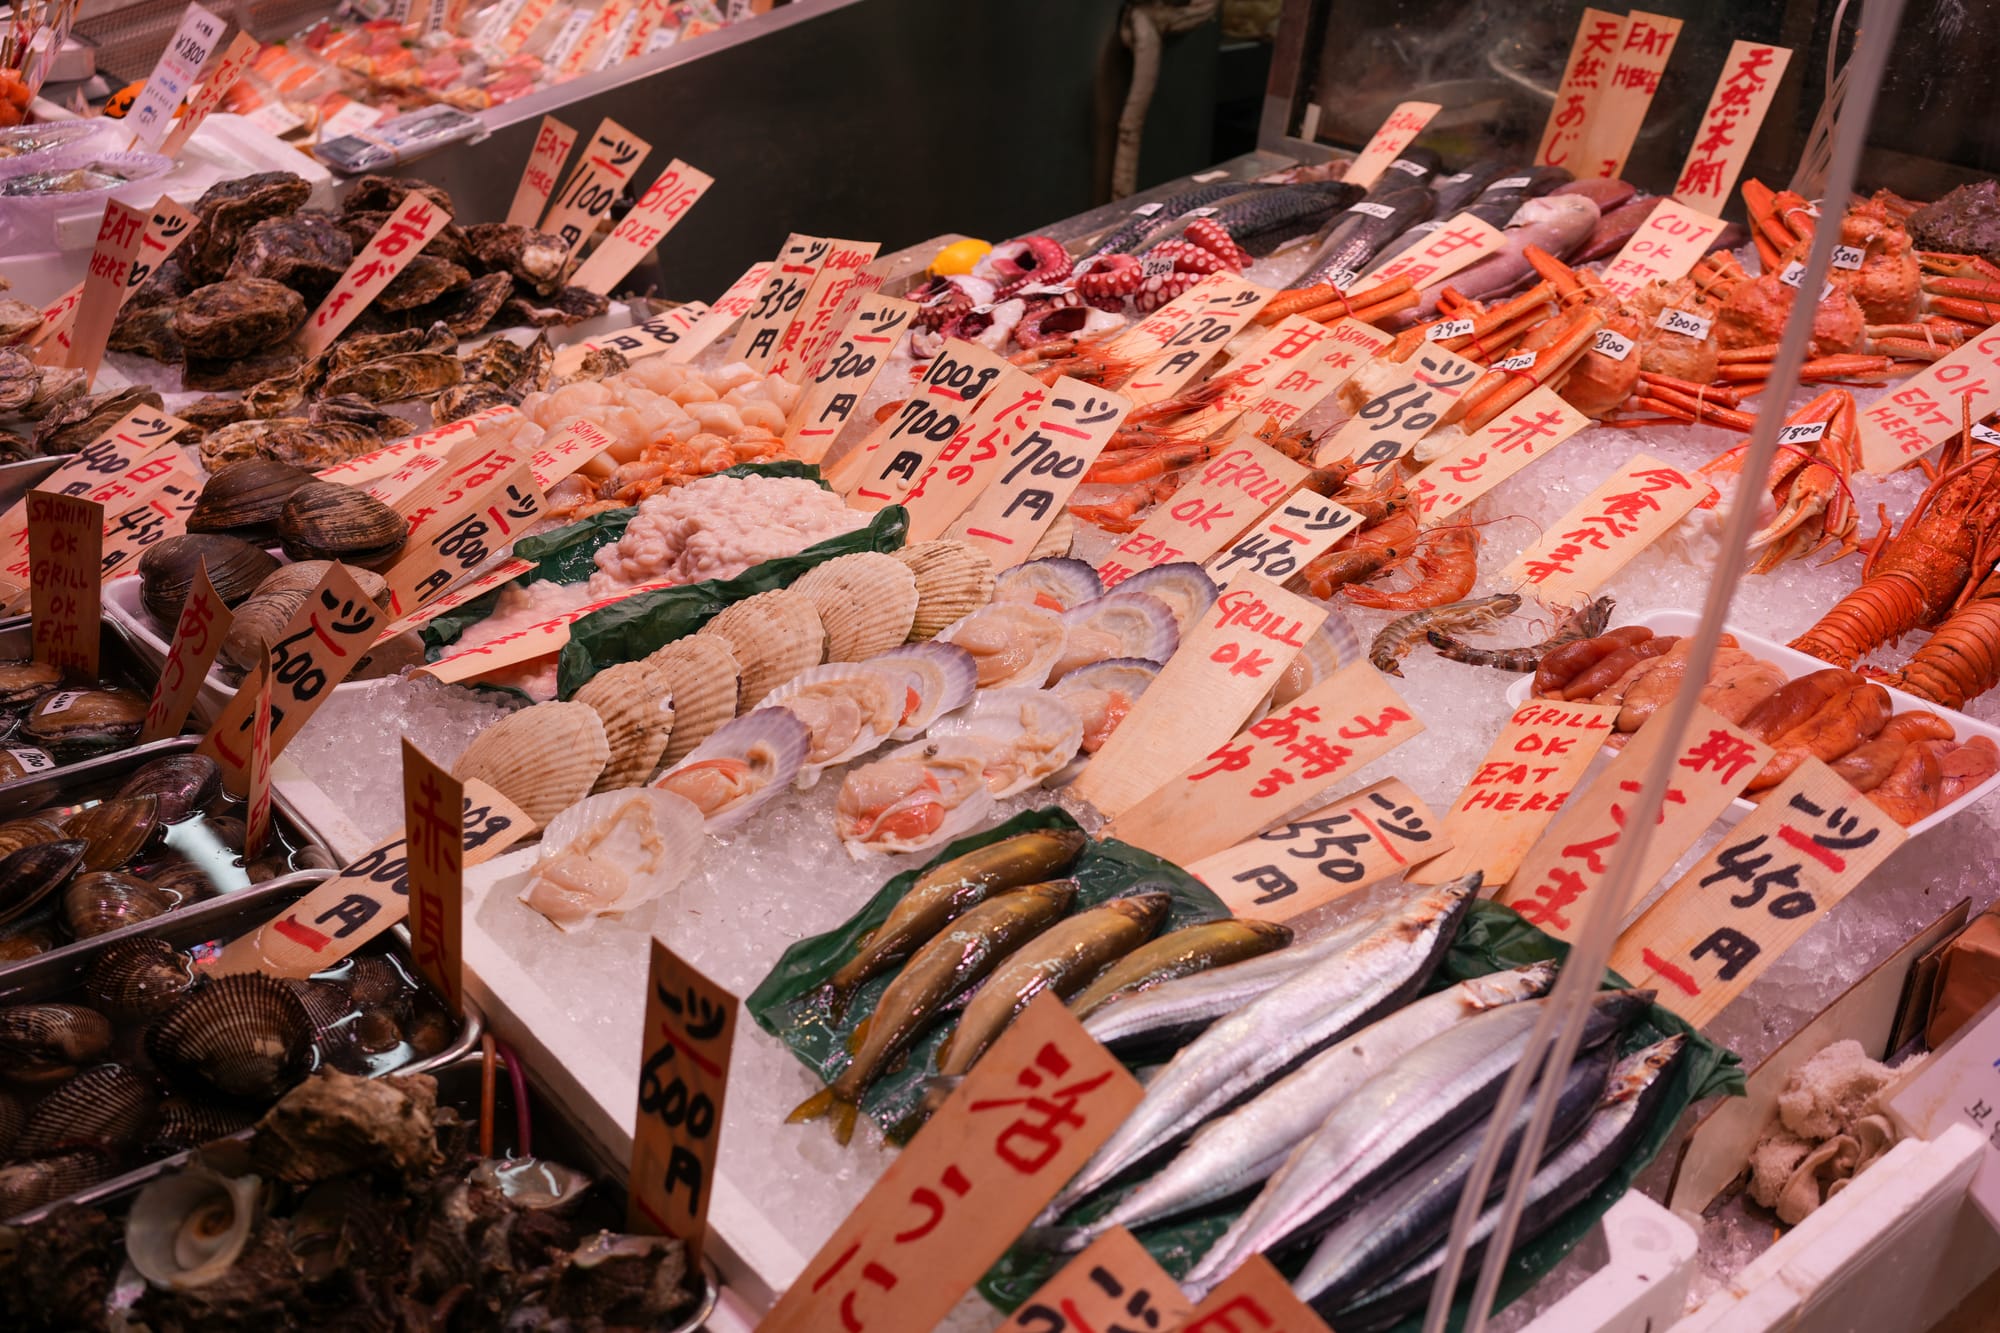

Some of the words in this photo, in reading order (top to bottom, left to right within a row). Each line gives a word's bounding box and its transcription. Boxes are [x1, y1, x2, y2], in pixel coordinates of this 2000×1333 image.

[1624, 22, 1674, 56] EAT
[1545, 22, 1618, 166] 天然あじ
[1612, 63, 1661, 95] HERE
[535, 127, 570, 165] EAT
[598, 136, 638, 165] 一ツ
[526, 165, 554, 198] HERE
[637, 171, 698, 221] BIG
[97, 204, 142, 249] EAT
[613, 218, 661, 248] SIZE
[1650, 214, 1713, 243] CUT
[789, 242, 829, 263] 一ツ
[1631, 241, 1674, 260] OK
[89, 251, 127, 287] HERE
[1611, 259, 1660, 278] EAT
[751, 278, 806, 320] 350
[1209, 291, 1261, 308] 一ツ
[859, 306, 908, 333] 一ツ
[1161, 317, 1232, 349] 120
[1665, 312, 1701, 333] 3000
[745, 328, 780, 358] 円
[814, 341, 877, 384] 300
[1156, 350, 1200, 375] 円
[1323, 352, 1356, 370] OK
[1420, 356, 1476, 388] 一ツ
[1276, 370, 1324, 392] EAT
[1934, 364, 1990, 404] OK
[818, 393, 858, 423] 円
[890, 399, 961, 442] 700
[1051, 397, 1119, 425] 一ツ
[1255, 397, 1301, 421] HERE
[1358, 383, 1438, 431] 650
[1891, 387, 1954, 427] EAT
[131, 417, 173, 438] 一ツ
[1865, 406, 1934, 455] HERE
[62, 439, 131, 474] 400
[554, 439, 579, 455] OK
[1000, 430, 1085, 485] 700
[1354, 440, 1403, 473] 円
[1415, 409, 1565, 514] 赤えび
[879, 450, 923, 482] 円
[1200, 449, 1291, 506] GRILL
[506, 484, 538, 518] 一ツ
[1001, 488, 1055, 521] 円
[1170, 497, 1235, 532] OK
[106, 505, 167, 546] 450
[1284, 506, 1352, 531] 一ツ
[50, 529, 79, 555] OK
[432, 512, 489, 569] 1800
[1119, 532, 1186, 567] EAT
[1214, 533, 1297, 577] 450
[32, 560, 89, 590] GRILL
[414, 568, 453, 602] 円
[49, 595, 78, 615] OK
[320, 588, 375, 634] 一ツ
[1209, 590, 1304, 649] GRILL
[35, 620, 80, 645] EAT
[1209, 642, 1275, 680] OK
[1512, 704, 1612, 731] GRILL
[1513, 733, 1578, 759] OK
[1470, 761, 1560, 789] EAT
[1367, 792, 1432, 843] 一ツ
[1461, 789, 1572, 813] HERE
[1789, 792, 1881, 851] 一ツ
[1231, 864, 1299, 905] 円
[1698, 834, 1818, 920] 450
[315, 893, 382, 939] 円
[1689, 926, 1762, 983] 円
[656, 979, 726, 1041] 一ツ
[638, 1041, 715, 1140] 600
[663, 1145, 703, 1218] 円
